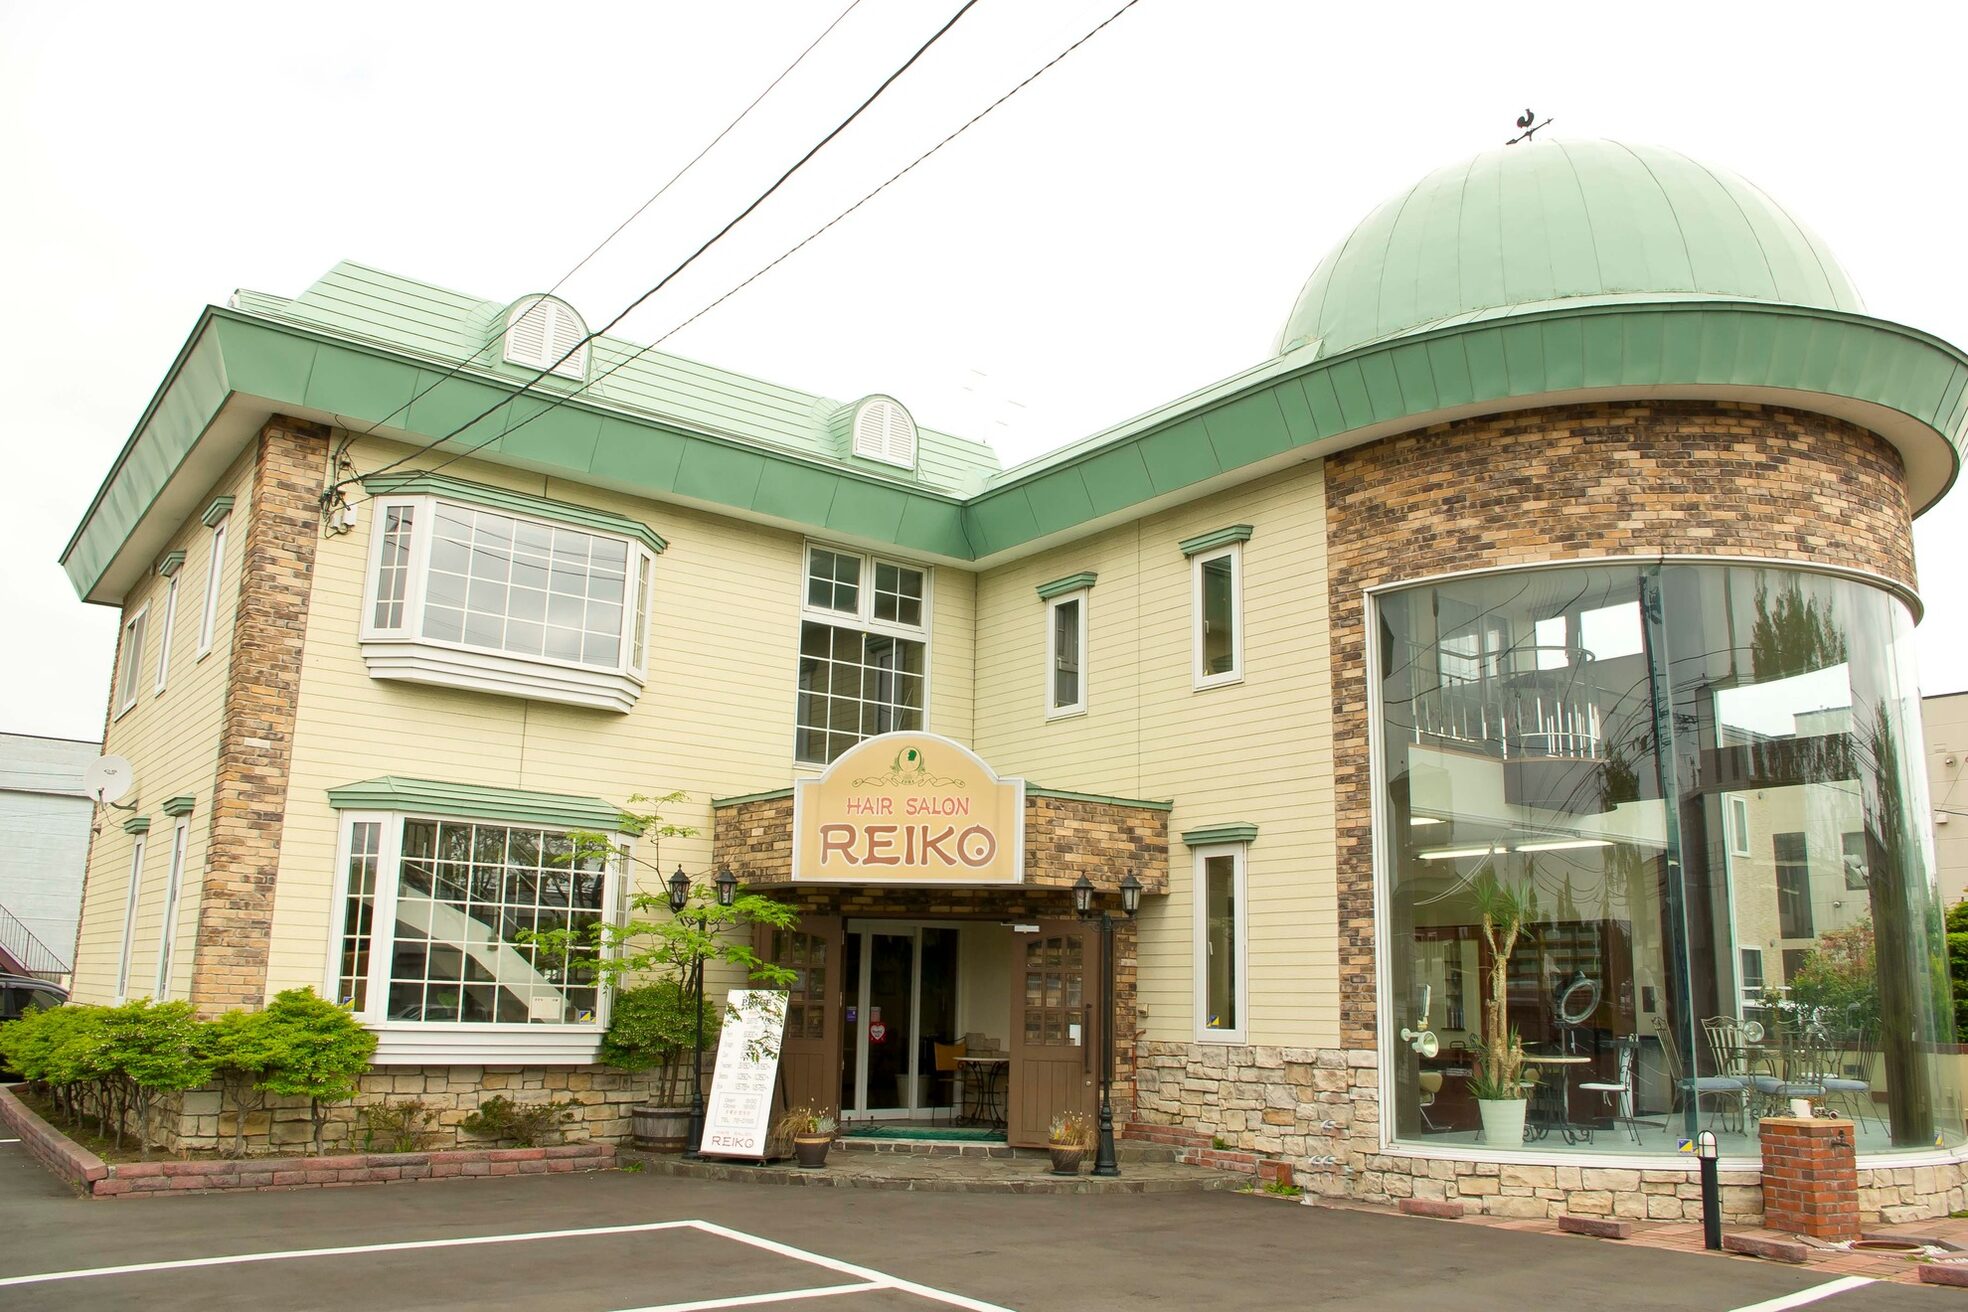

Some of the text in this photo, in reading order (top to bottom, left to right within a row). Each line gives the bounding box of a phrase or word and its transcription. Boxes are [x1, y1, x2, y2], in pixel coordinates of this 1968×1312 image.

[847, 797, 970, 816] HAIR SALON
[819, 824, 996, 867] REIKO
[712, 1135, 754, 1148] REIKO
